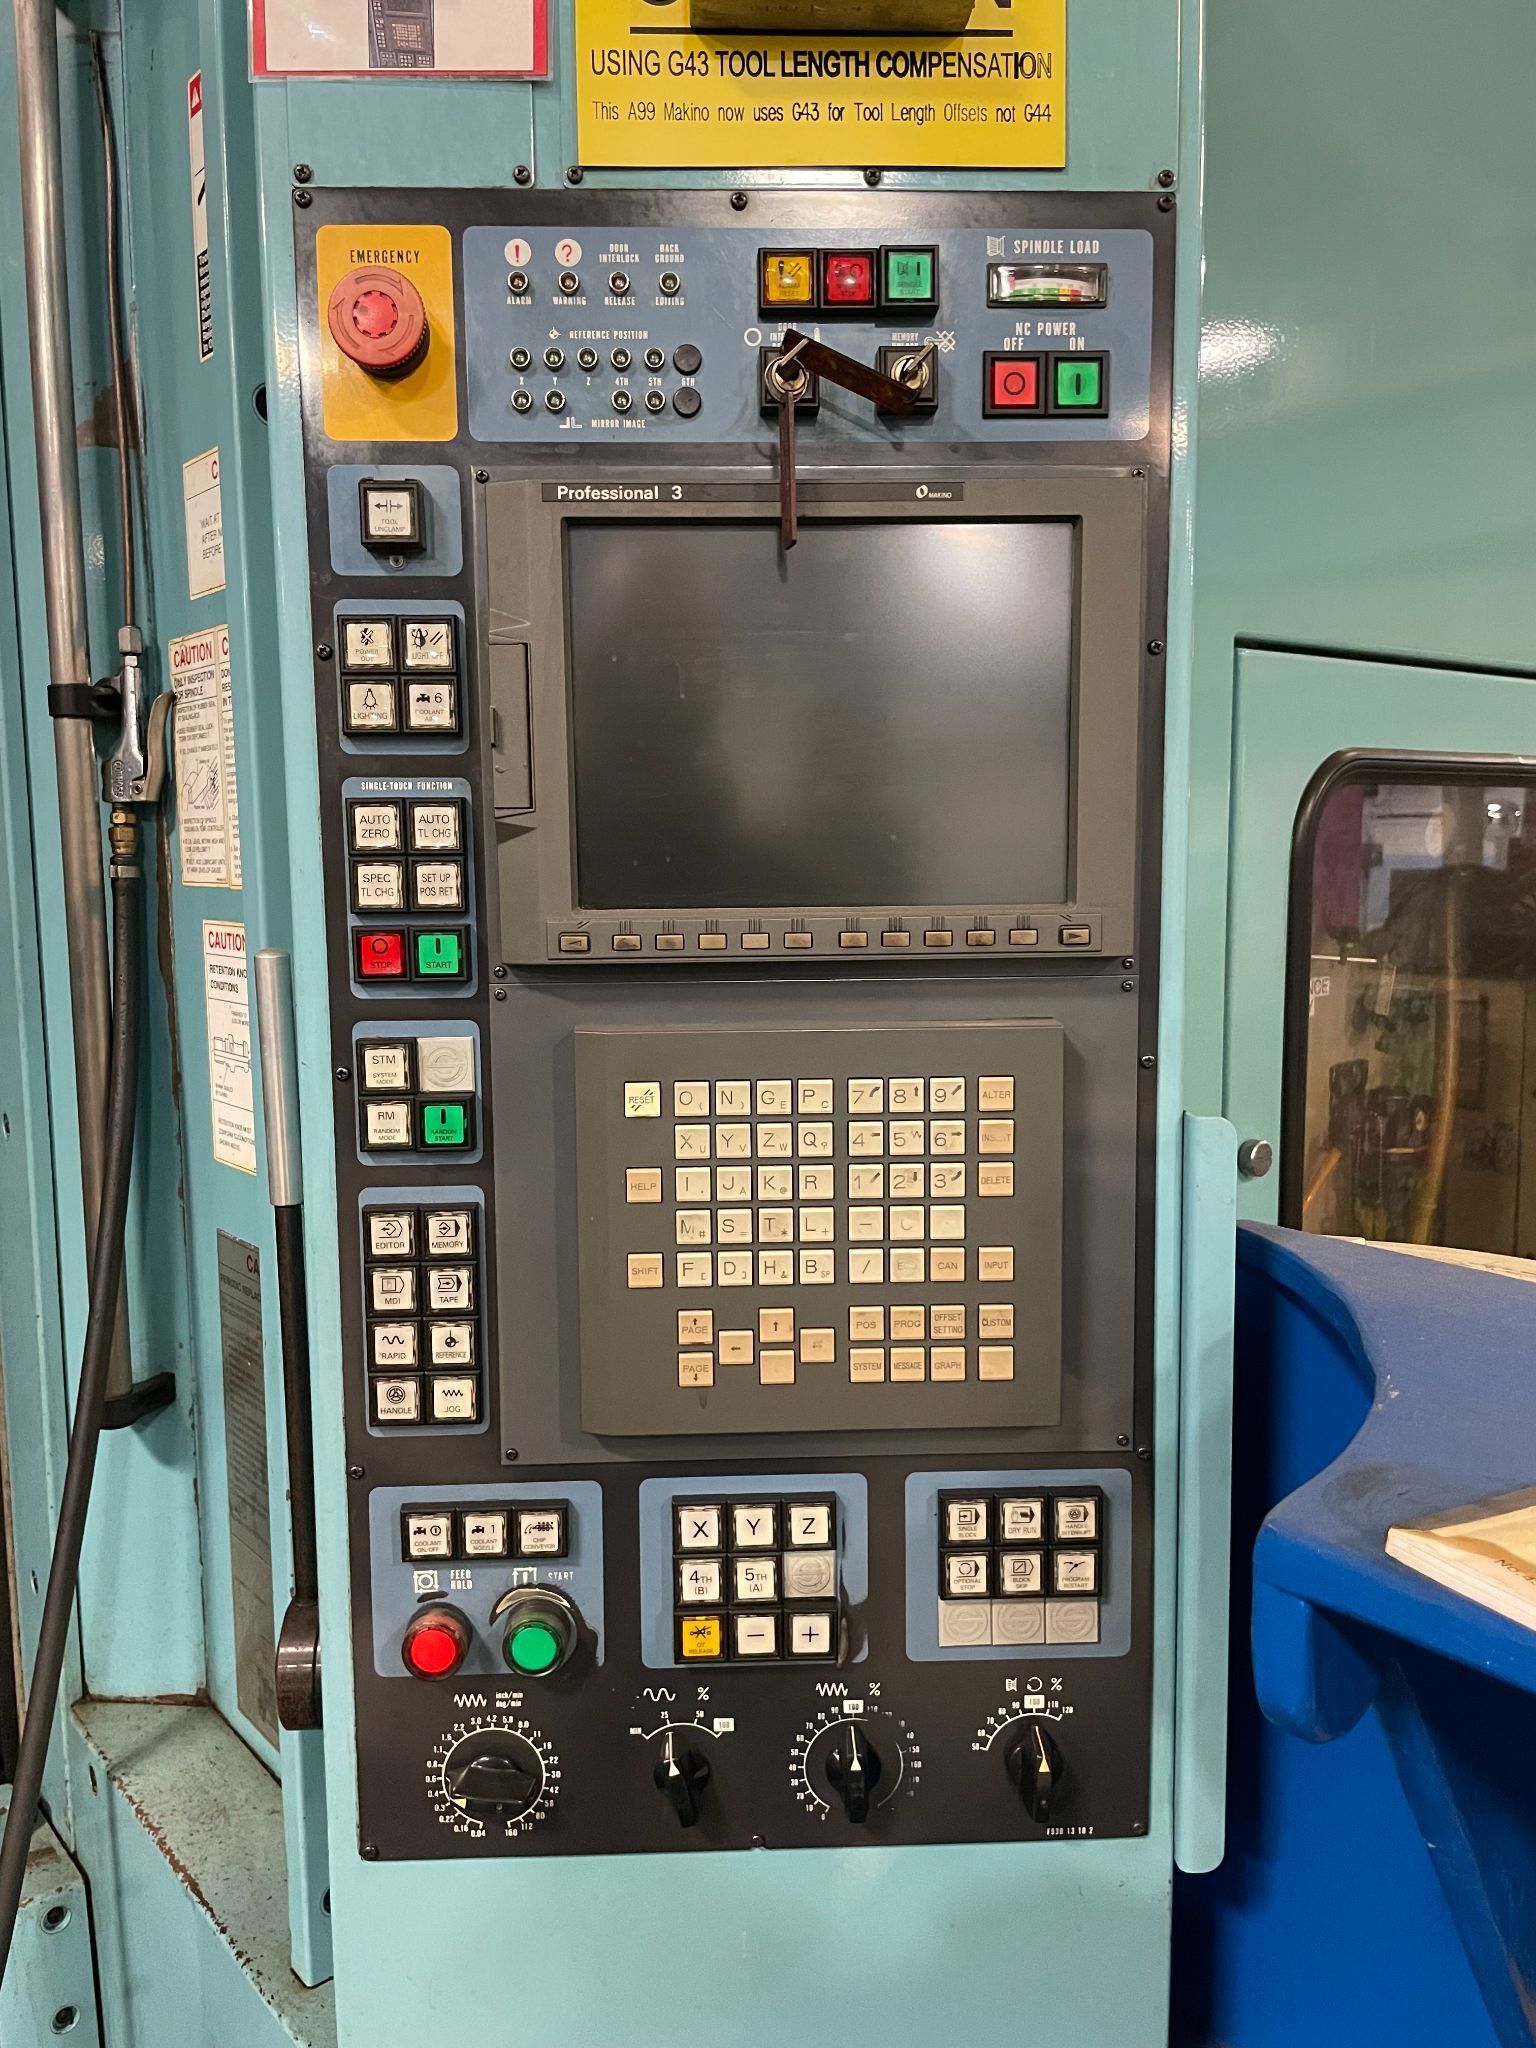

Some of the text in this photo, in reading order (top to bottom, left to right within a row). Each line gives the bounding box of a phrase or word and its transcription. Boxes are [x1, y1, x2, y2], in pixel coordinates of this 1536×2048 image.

[591, 48, 1052, 79] USING G43 TOOL LENGTH COMPENSATION
[592, 101, 1052, 125] This A99 Makino now uses G43 for Tool Length Offsets not G44
[610, 244, 628, 252] DOOR
[660, 244, 679, 252] BACK
[1014, 240, 1100, 254] SPINDLE LOAD
[350, 250, 420, 264] EMERGENCY
[600, 254, 639, 263] INTERLOCK
[655, 254, 684, 263] GROUND
[507, 296, 532, 304] ALARM
[553, 297, 586, 305] WARNING
[605, 297, 635, 305] RELEASE
[656, 297, 684, 305] EDITING
[570, 331, 648, 339] REFERENCE POSITION
[1016, 322, 1076, 336] NC POWER
[1004, 338, 1024, 351] OFF
[1069, 338, 1084, 351] ON
[682, 378, 695, 386] 6TH
[591, 419, 646, 428] MIRROR IMAGE
[558, 486, 682, 499] Professional 3
[174, 641, 212, 668] CAUTION
[435, 693, 442, 703] 6
[361, 782, 452, 790] SINGLE-TOUCH FUNCTION
[360, 815, 390, 824] AUTO
[419, 814, 450, 824] AUTO
[362, 829, 389, 838] ZERO
[418, 829, 451, 838] TL CHG
[363, 874, 390, 883] SPEC
[422, 874, 450, 883] SET UP
[362, 887, 394, 896] TL CHG
[420, 887, 453, 896] POS RET
[209, 931, 245, 952] CAUTION
[210, 964, 235, 976] RETENTION
[211, 980, 238, 993] CONDITIONS
[372, 1055, 396, 1064] STM
[629, 1096, 655, 1104] RESET
[721, 1090, 733, 1104] N
[761, 1091, 774, 1104] G
[802, 1090, 815, 1103] P
[852, 1090, 864, 1104] 7
[894, 1089, 906, 1103] 8
[934, 1089, 946, 1102] 9
[378, 1111, 395, 1120] RM
[680, 1135, 692, 1149] X
[722, 1134, 733, 1148] Y
[763, 1133, 775, 1147] Z
[803, 1132, 817, 1148] Q
[853, 1133, 864, 1147] 4
[894, 1133, 905, 1146] 5
[934, 1133, 946, 1146] 6
[764, 1176, 775, 1190] K
[934, 1174, 946, 1188] 3
[981, 1176, 1010, 1184] DELETE
[764, 1261, 776, 1274] H
[693, 1521, 708, 1538] X
[747, 1518, 760, 1535] Y
[802, 1518, 816, 1534] Z
[450, 1570, 471, 1580] FEED
[548, 1572, 574, 1581] START
[690, 1570, 712, 1584] 4TH
[745, 1568, 767, 1581] 5TH
[450, 1580, 472, 1590] HOLD
[695, 1587, 707, 1595] (B)
[750, 1584, 763, 1592] (A)
